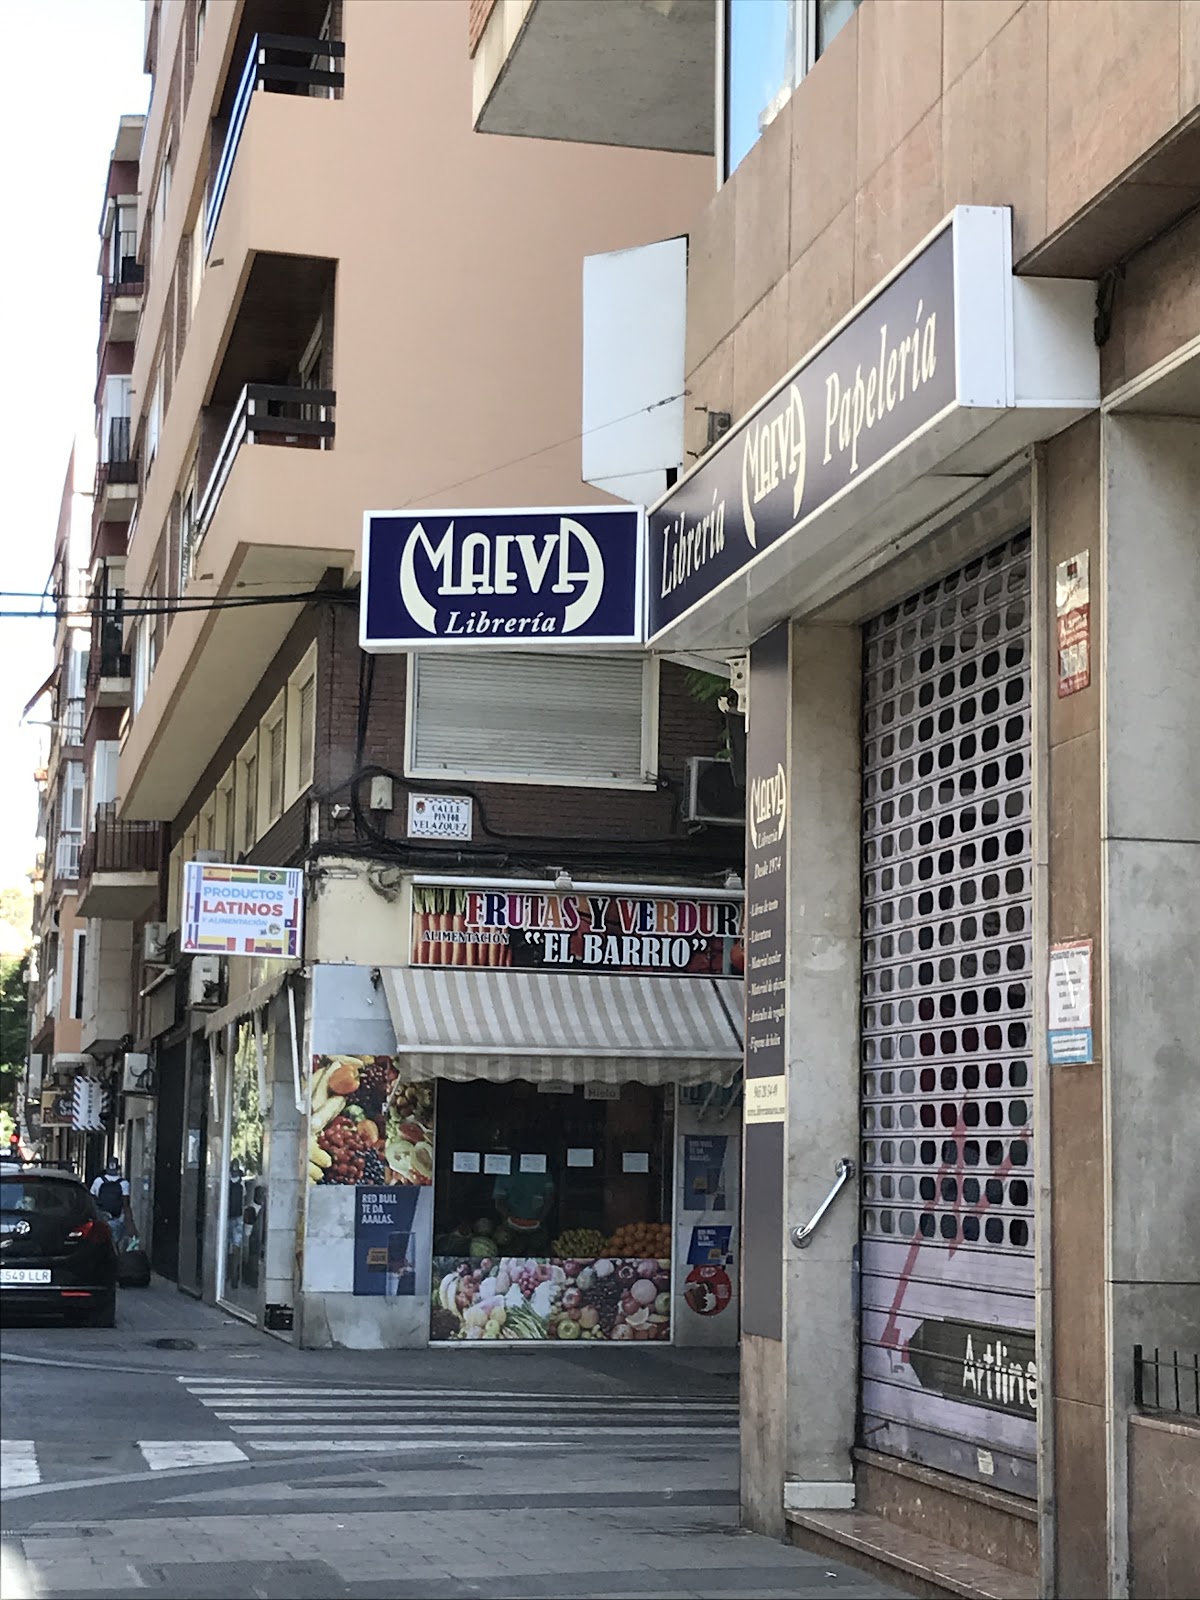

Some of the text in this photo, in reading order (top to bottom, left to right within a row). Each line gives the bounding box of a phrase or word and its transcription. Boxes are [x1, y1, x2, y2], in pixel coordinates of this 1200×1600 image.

[661, 299, 937, 598] Librería MAEVA Papelería
[400, 517, 604, 634] MAEVA
[444, 611, 557, 634] Librería
[432, 804, 461, 813] CALLE
[750, 763, 786, 849] MAEVA
[434, 813, 460, 822] PINTOR
[413, 820, 467, 831] VELAZQUEZ
[203, 886, 284, 900] PRODUCTOS
[202, 900, 284, 916] LATINOS
[465, 891, 744, 937] FRUTAS Y VERDUR
[422, 930, 510, 945] ALIMENTACIÓN
[362, 1193, 378, 1203] RED
[362, 1204, 384, 1213] TE DA
[28, 1271, 49, 1281] LLR
